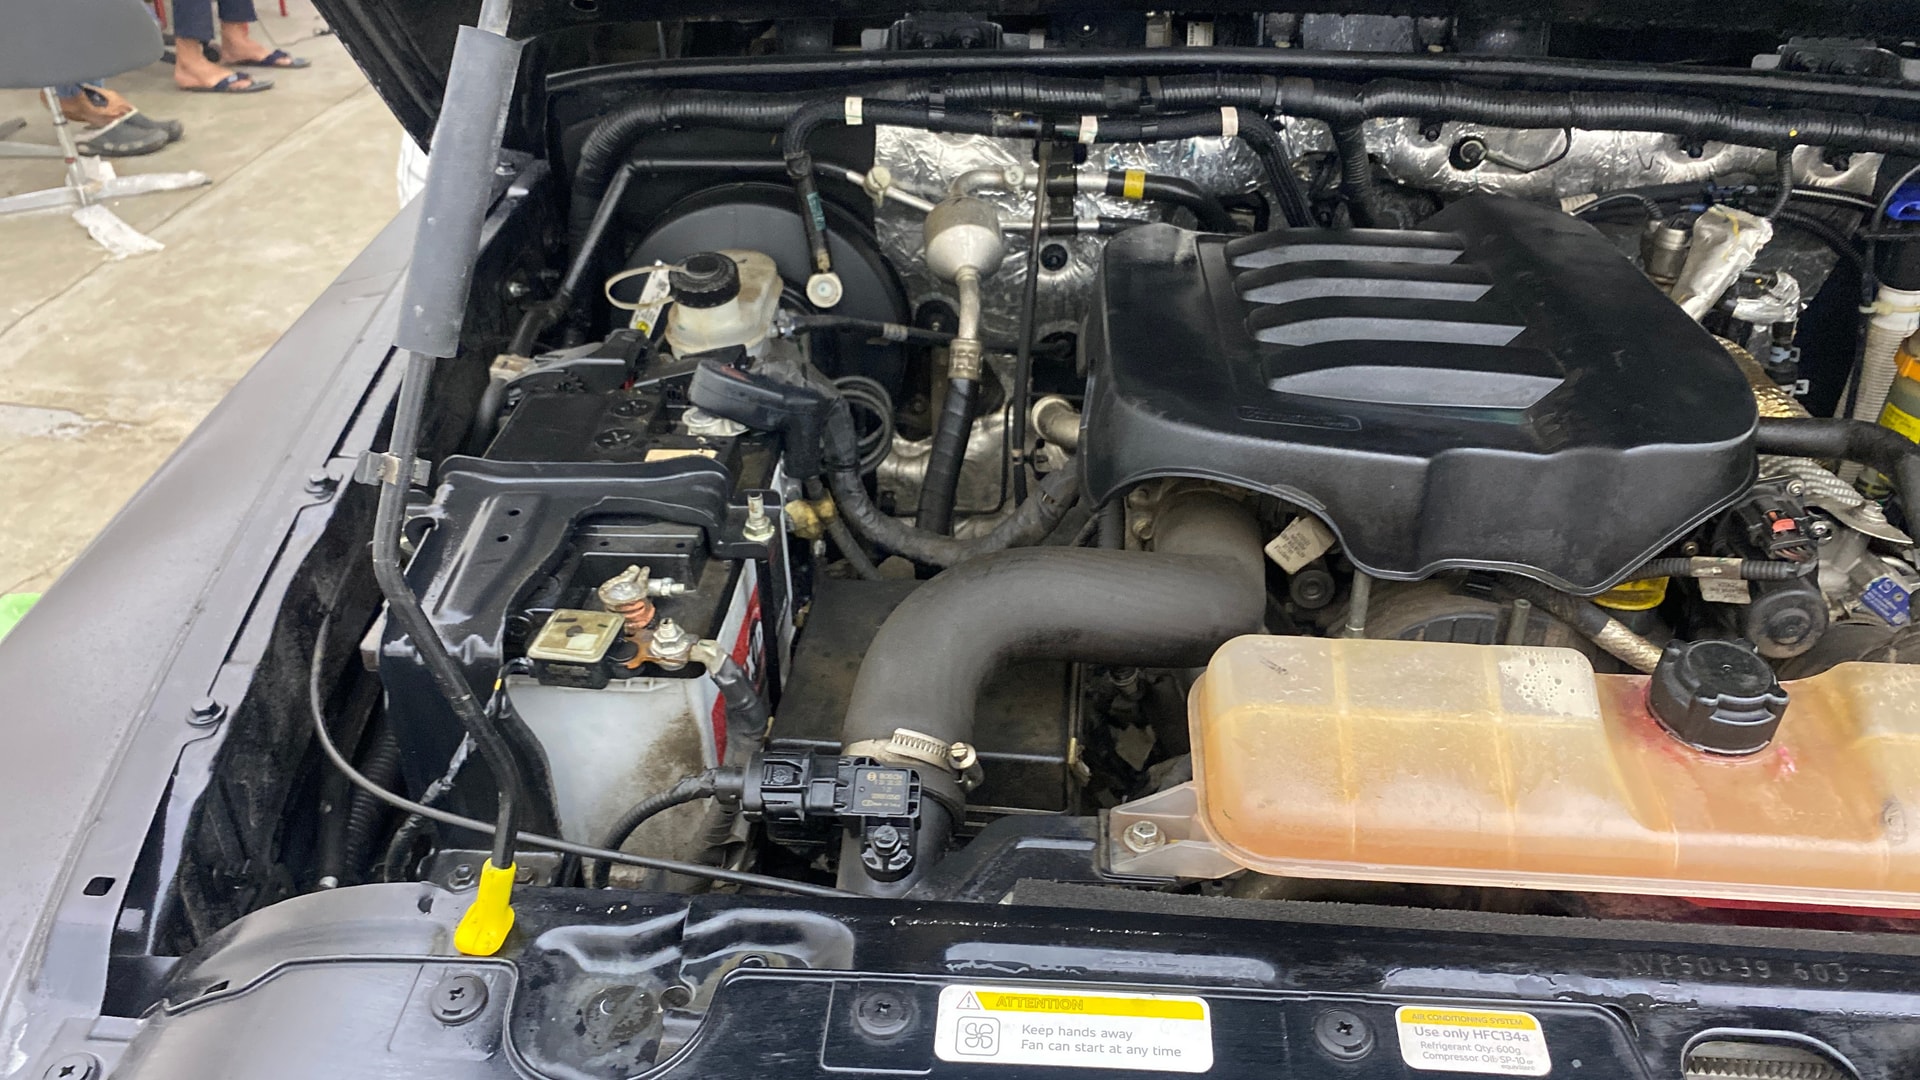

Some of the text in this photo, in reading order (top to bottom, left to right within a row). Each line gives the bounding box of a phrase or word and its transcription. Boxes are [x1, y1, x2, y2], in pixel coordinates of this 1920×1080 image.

[1793, 962, 1849, 983] 603
[996, 996, 1084, 1011] ATTENTION
[1411, 1013, 1425, 1021] AIR
[1427, 1014, 1488, 1024] CONDITIONING
[1022, 1024, 1133, 1041] Keep hands away
[1414, 1026, 1530, 1043] Use only HFC134a
[1021, 1039, 1182, 1058] Fan can start at any time
[1420, 1041, 1521, 1056] Refrigerant Qty: 600g
[1422, 1052, 1479, 1063] Compressor
[1499, 1057, 1526, 1066] SP-10
